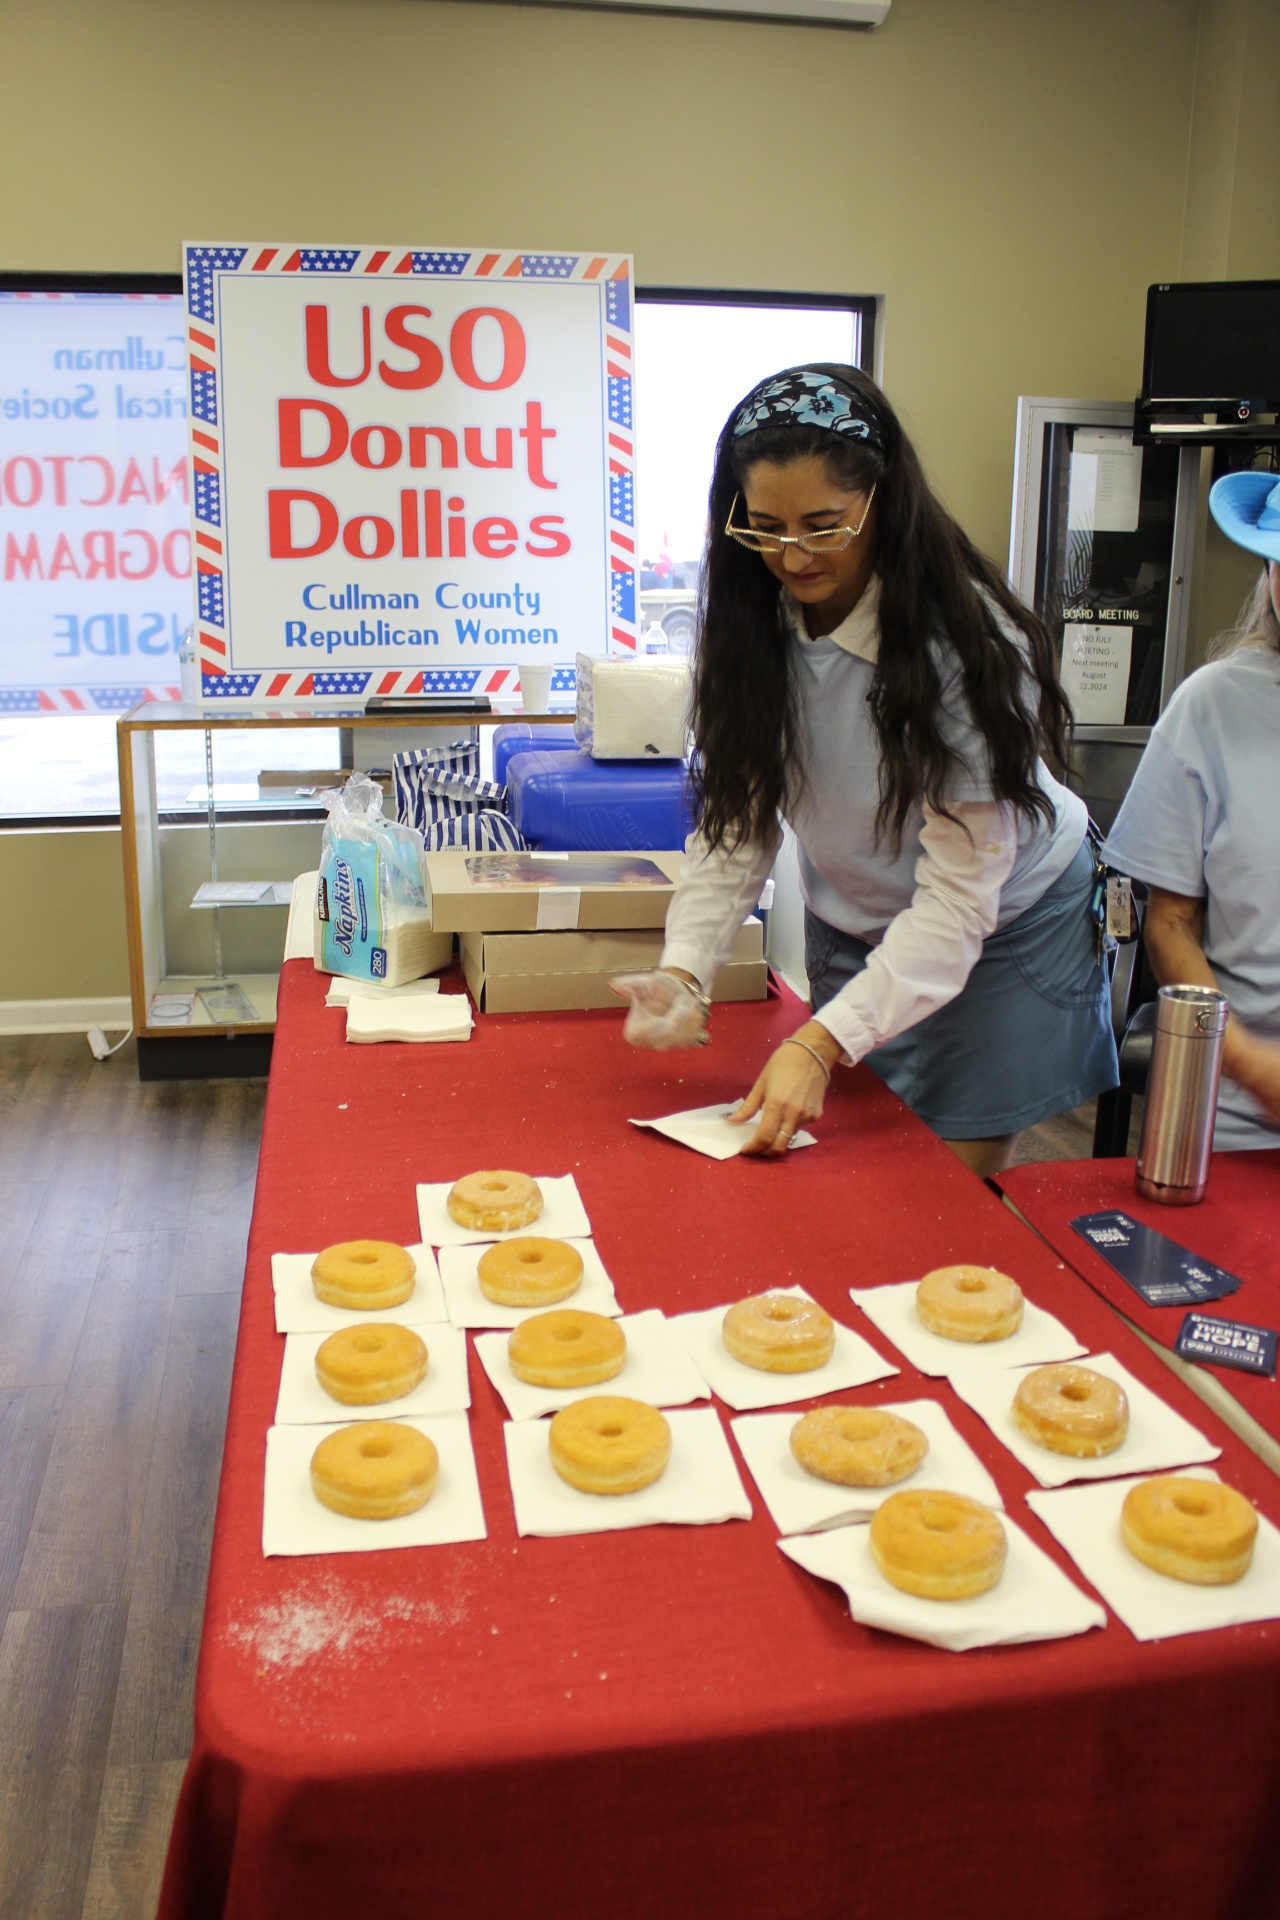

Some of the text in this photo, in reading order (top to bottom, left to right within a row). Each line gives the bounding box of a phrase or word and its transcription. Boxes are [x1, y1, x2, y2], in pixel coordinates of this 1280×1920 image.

[304, 304, 527, 391] USO
[277, 398, 558, 490] Donut
[267, 488, 572, 560] Dollies
[302, 582, 541, 616] Cullman County
[1063, 608, 1139, 620] BOARD MEETING
[285, 618, 559, 654] Republican Women
[1082, 635, 1112, 644] NO JULY
[1072, 658, 1119, 669] Next meeting
[1077, 647, 1110, 655] MEETING
[1081, 671, 1106, 679] August
[333, 857, 359, 957] Napkins
[373, 950, 383, 975] 280
[1193, 1328, 1265, 1355] HOPE.
[1197, 1323, 1242, 1338] THERE
